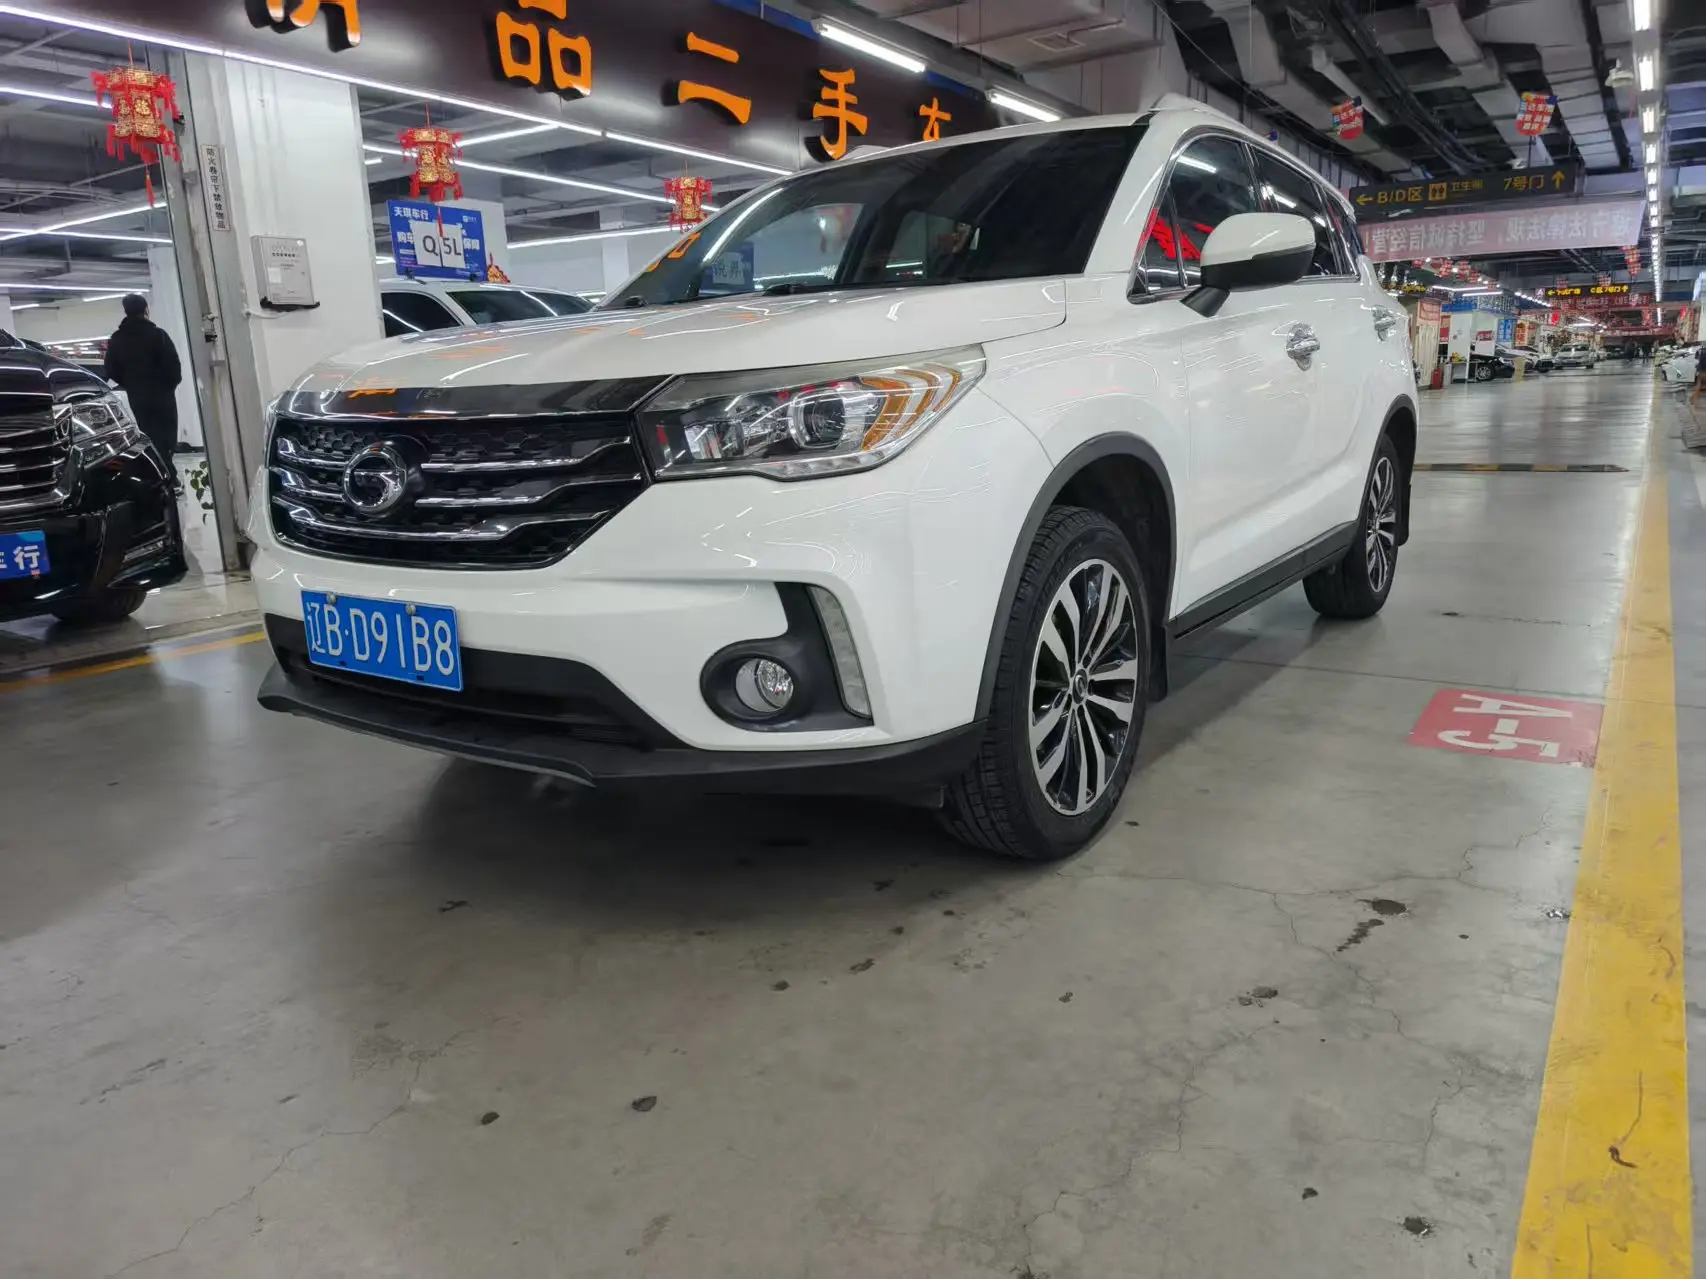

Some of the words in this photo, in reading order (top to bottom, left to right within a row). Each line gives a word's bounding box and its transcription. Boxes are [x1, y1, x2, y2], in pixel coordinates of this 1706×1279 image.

[1377, 186, 1423, 204] B/D区
[1452, 180, 1483, 191] 卫生间
[1504, 174, 1545, 192] 7号门
